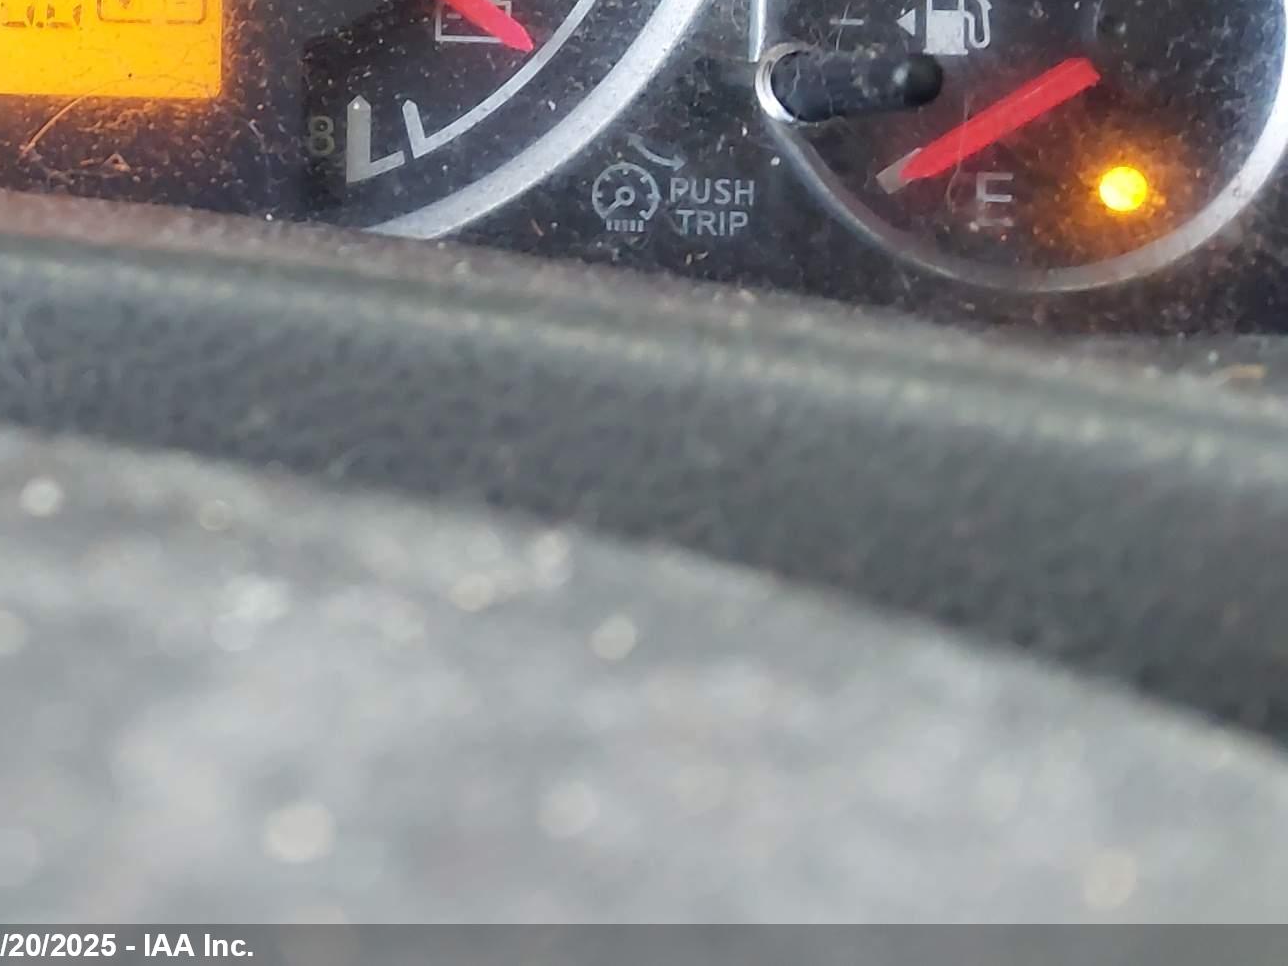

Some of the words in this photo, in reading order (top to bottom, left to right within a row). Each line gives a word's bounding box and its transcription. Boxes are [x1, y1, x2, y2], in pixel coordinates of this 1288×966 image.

[308, 115, 336, 156] 8
[669, 177, 756, 206] PUSH
[976, 171, 1013, 227] E
[675, 209, 749, 237] TRIP
